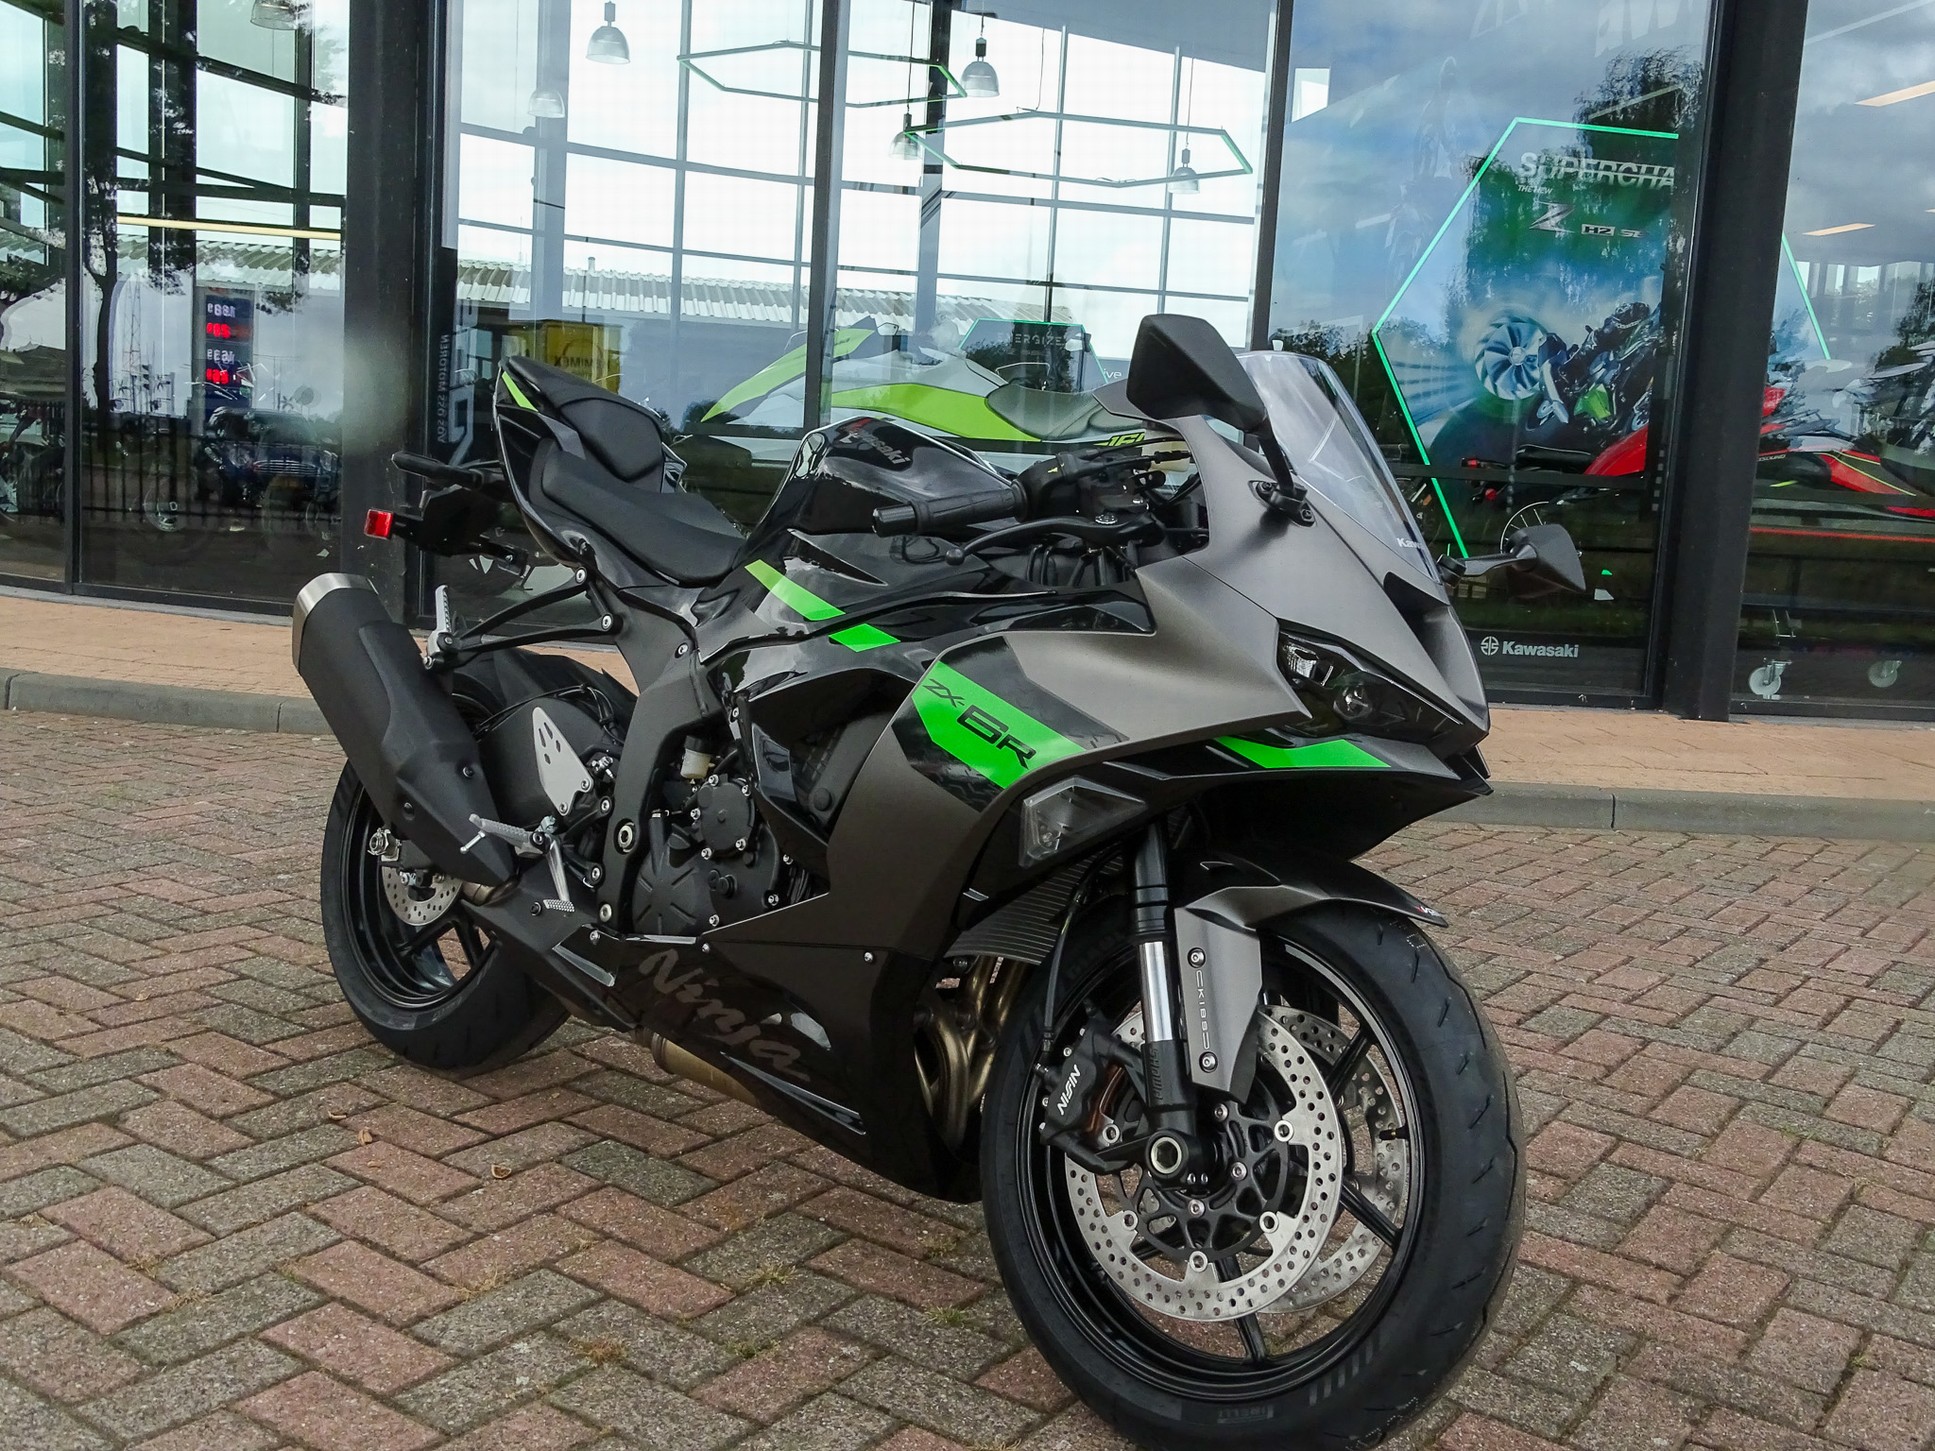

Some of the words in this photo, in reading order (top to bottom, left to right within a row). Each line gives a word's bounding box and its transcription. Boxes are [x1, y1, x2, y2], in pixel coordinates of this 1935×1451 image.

[1583, 225, 1613, 235] H2
[839, 431, 912, 465] Kasaki
[1502, 640, 1579, 658] Kawasaki
[922, 678, 1037, 770] ZX-6R
[638, 948, 811, 1082] Ninja
[1056, 1063, 1081, 1116] NISSIN
